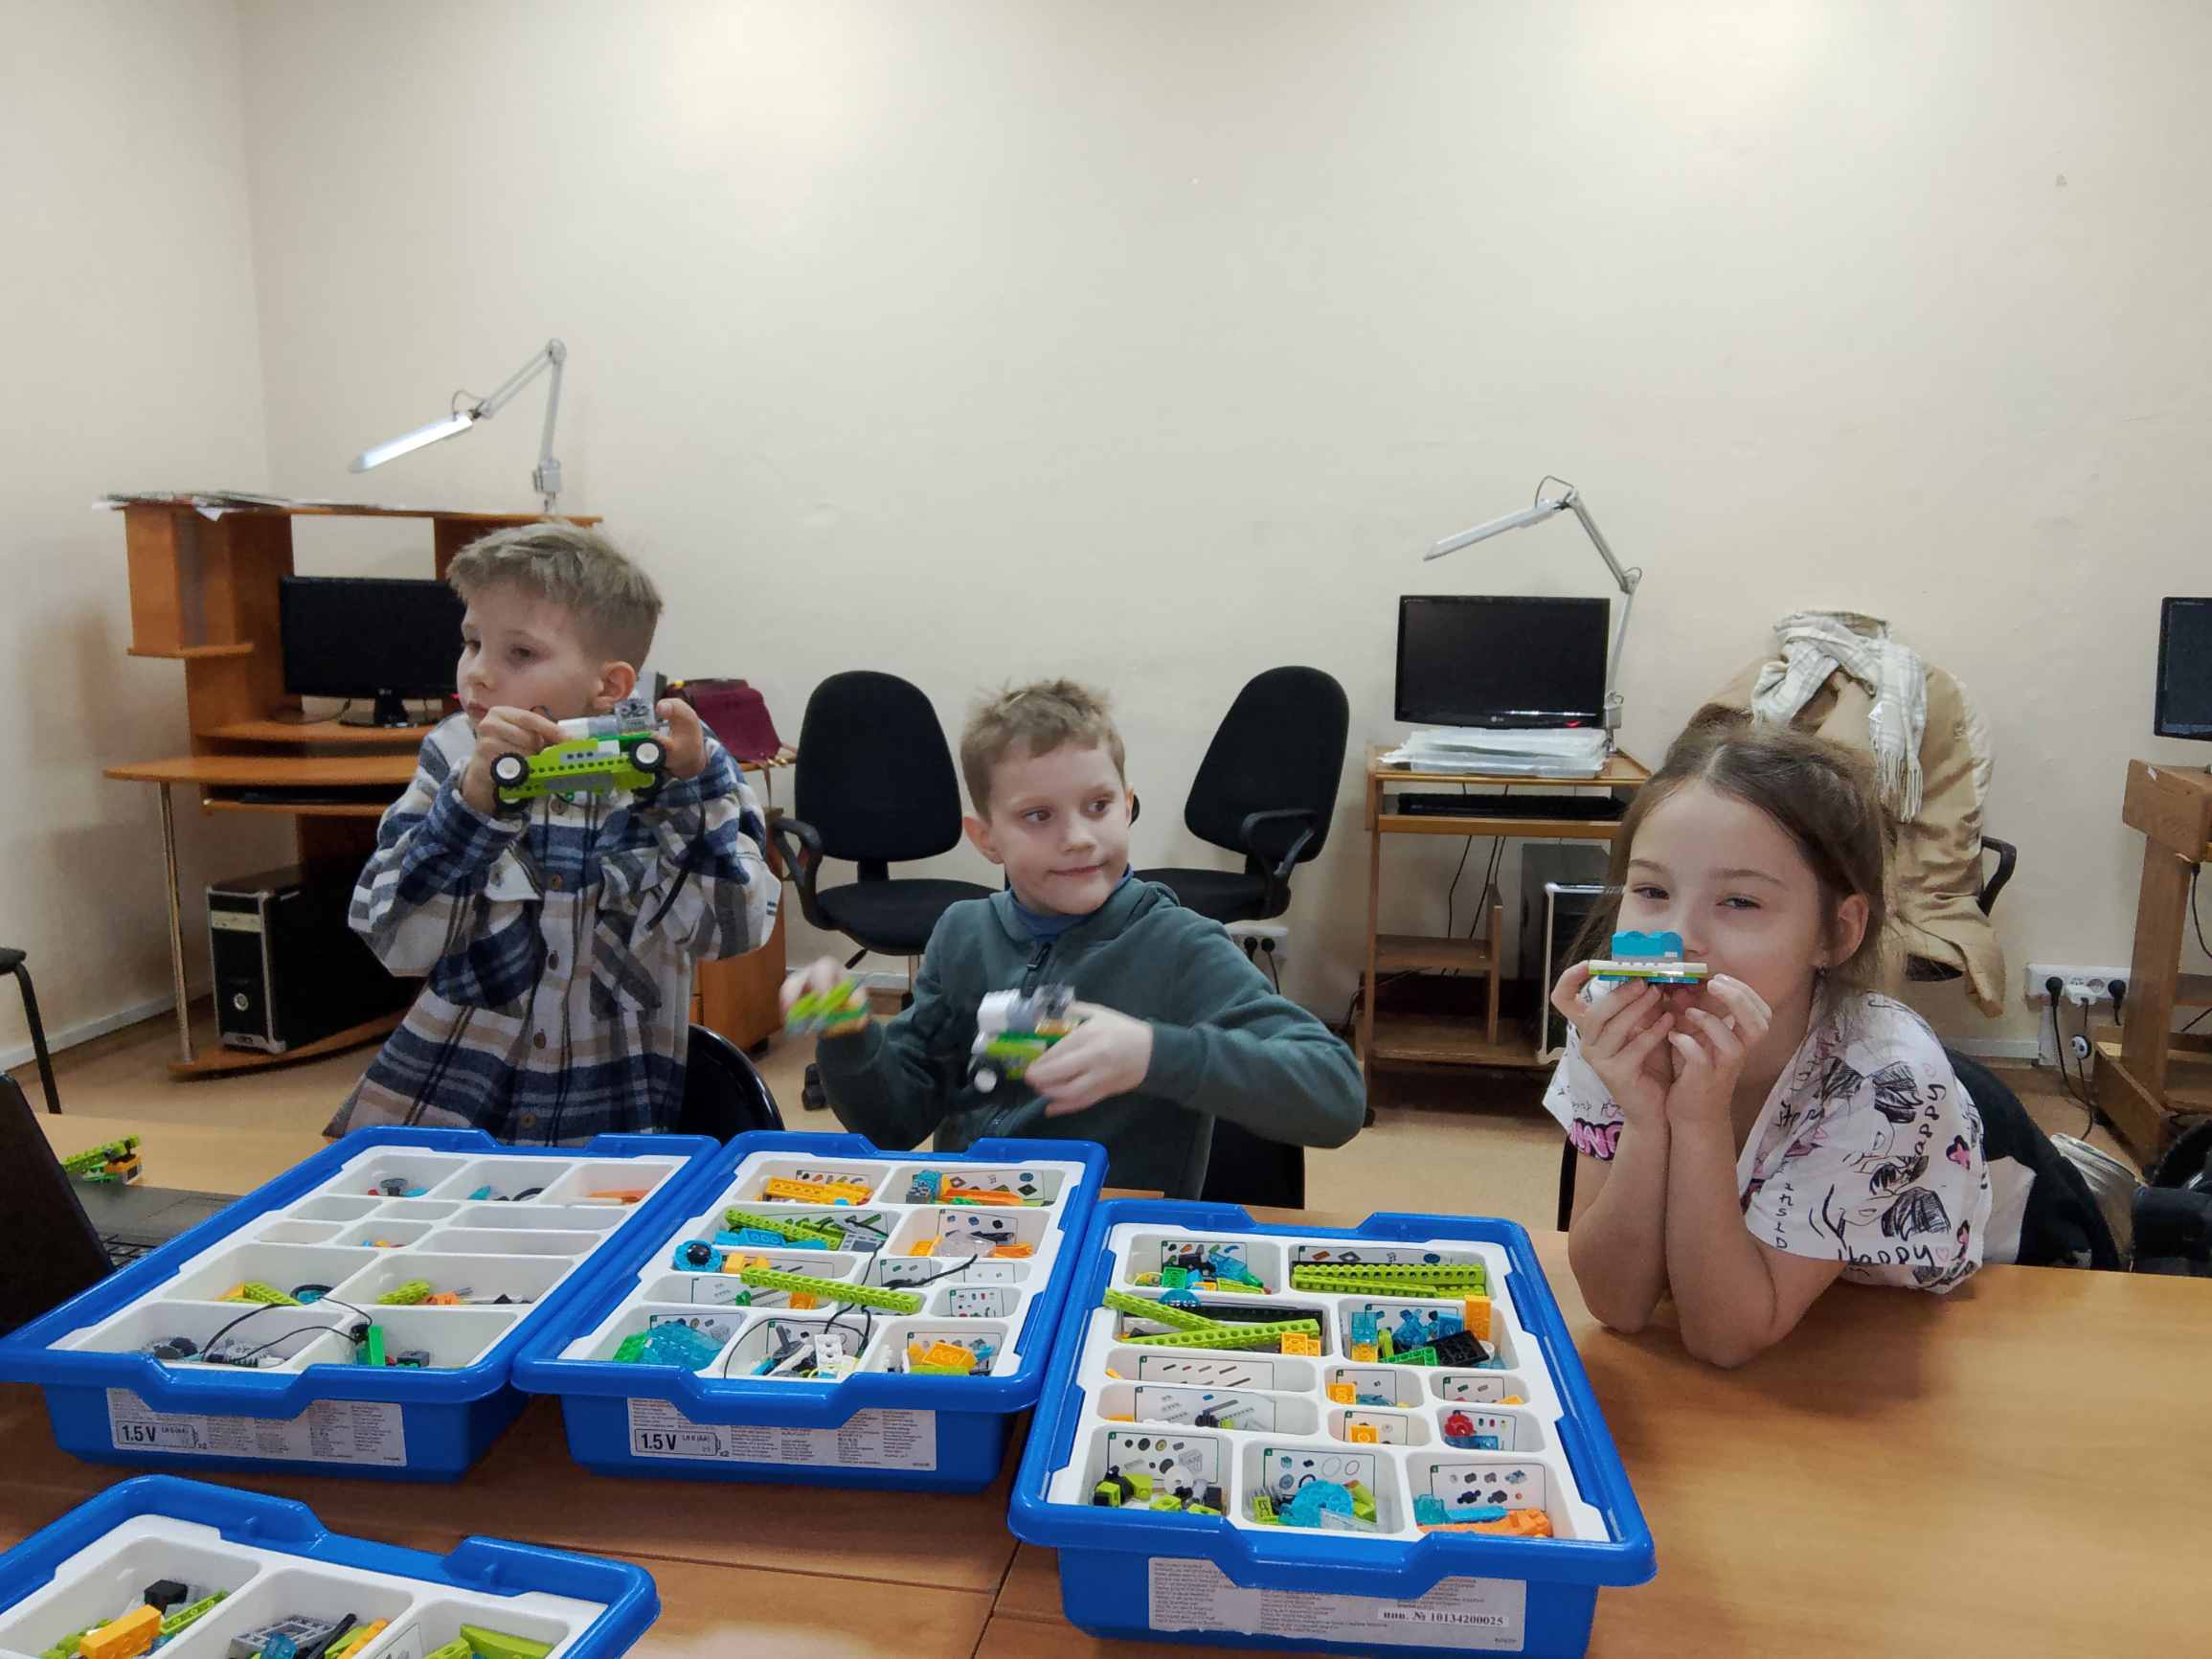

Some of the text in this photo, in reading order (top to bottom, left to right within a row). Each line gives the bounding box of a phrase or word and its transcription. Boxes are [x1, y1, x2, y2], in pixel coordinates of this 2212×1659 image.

[1914, 1083, 1946, 1155] appy
[122, 1424, 144, 1442] 1.5
[145, 1425, 156, 1443] V
[642, 1433, 664, 1450] 1.5
[666, 1434, 677, 1450] V
[1431, 1612, 1504, 1625] 10134200025
